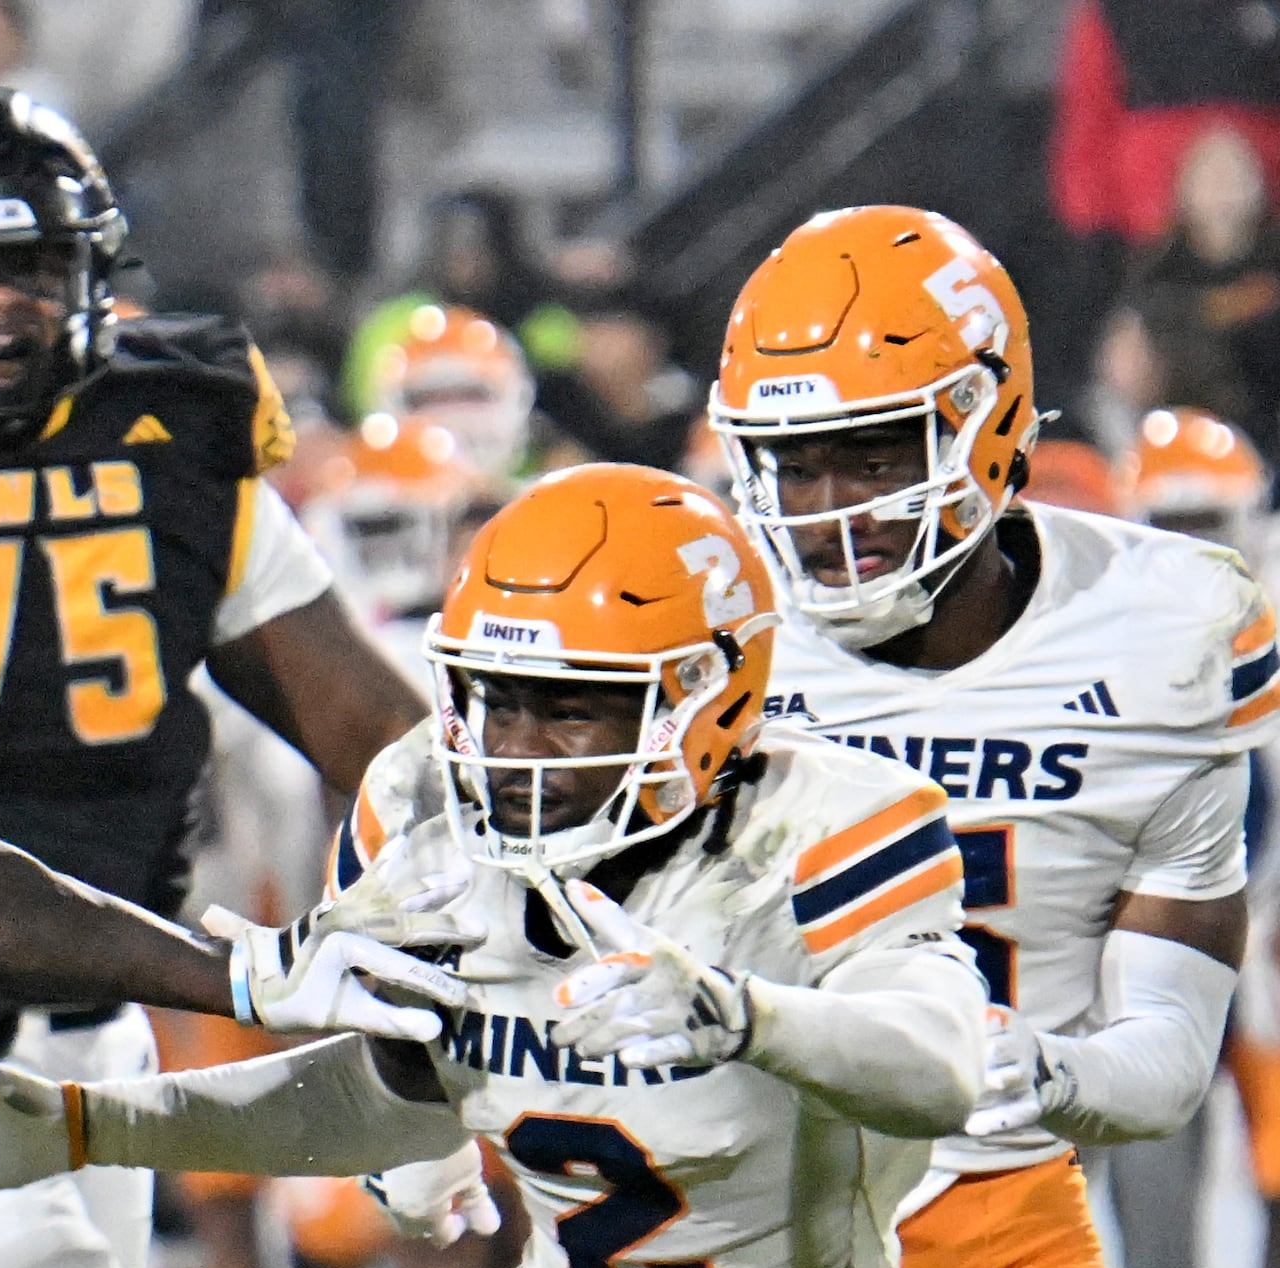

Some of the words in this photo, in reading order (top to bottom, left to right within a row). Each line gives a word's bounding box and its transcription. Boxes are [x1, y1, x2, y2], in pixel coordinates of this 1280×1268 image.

[922, 256, 1002, 350] 5
[759, 382, 817, 398] UNITY
[675, 533, 757, 629] 2
[483, 622, 541, 644] UNITY
